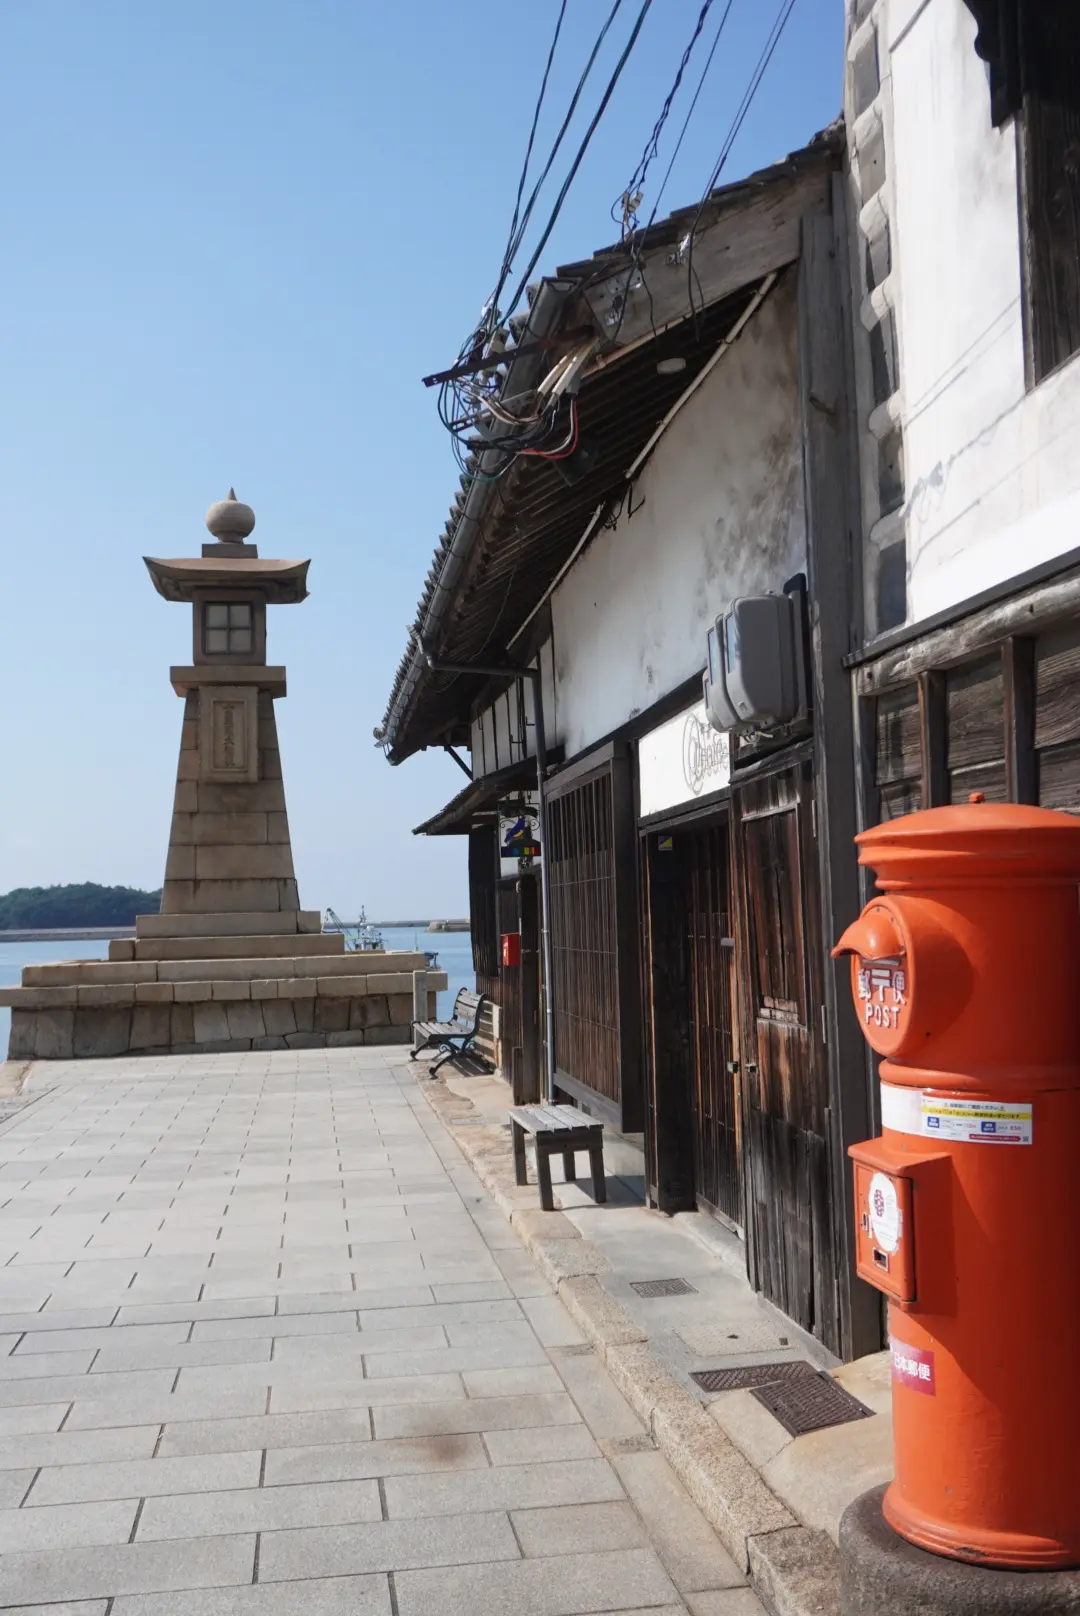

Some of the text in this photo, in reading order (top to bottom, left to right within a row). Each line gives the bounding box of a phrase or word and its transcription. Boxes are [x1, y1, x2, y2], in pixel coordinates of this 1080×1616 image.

[865, 1003, 900, 1028] POST
[893, 1352, 931, 1382] 日本郵便
